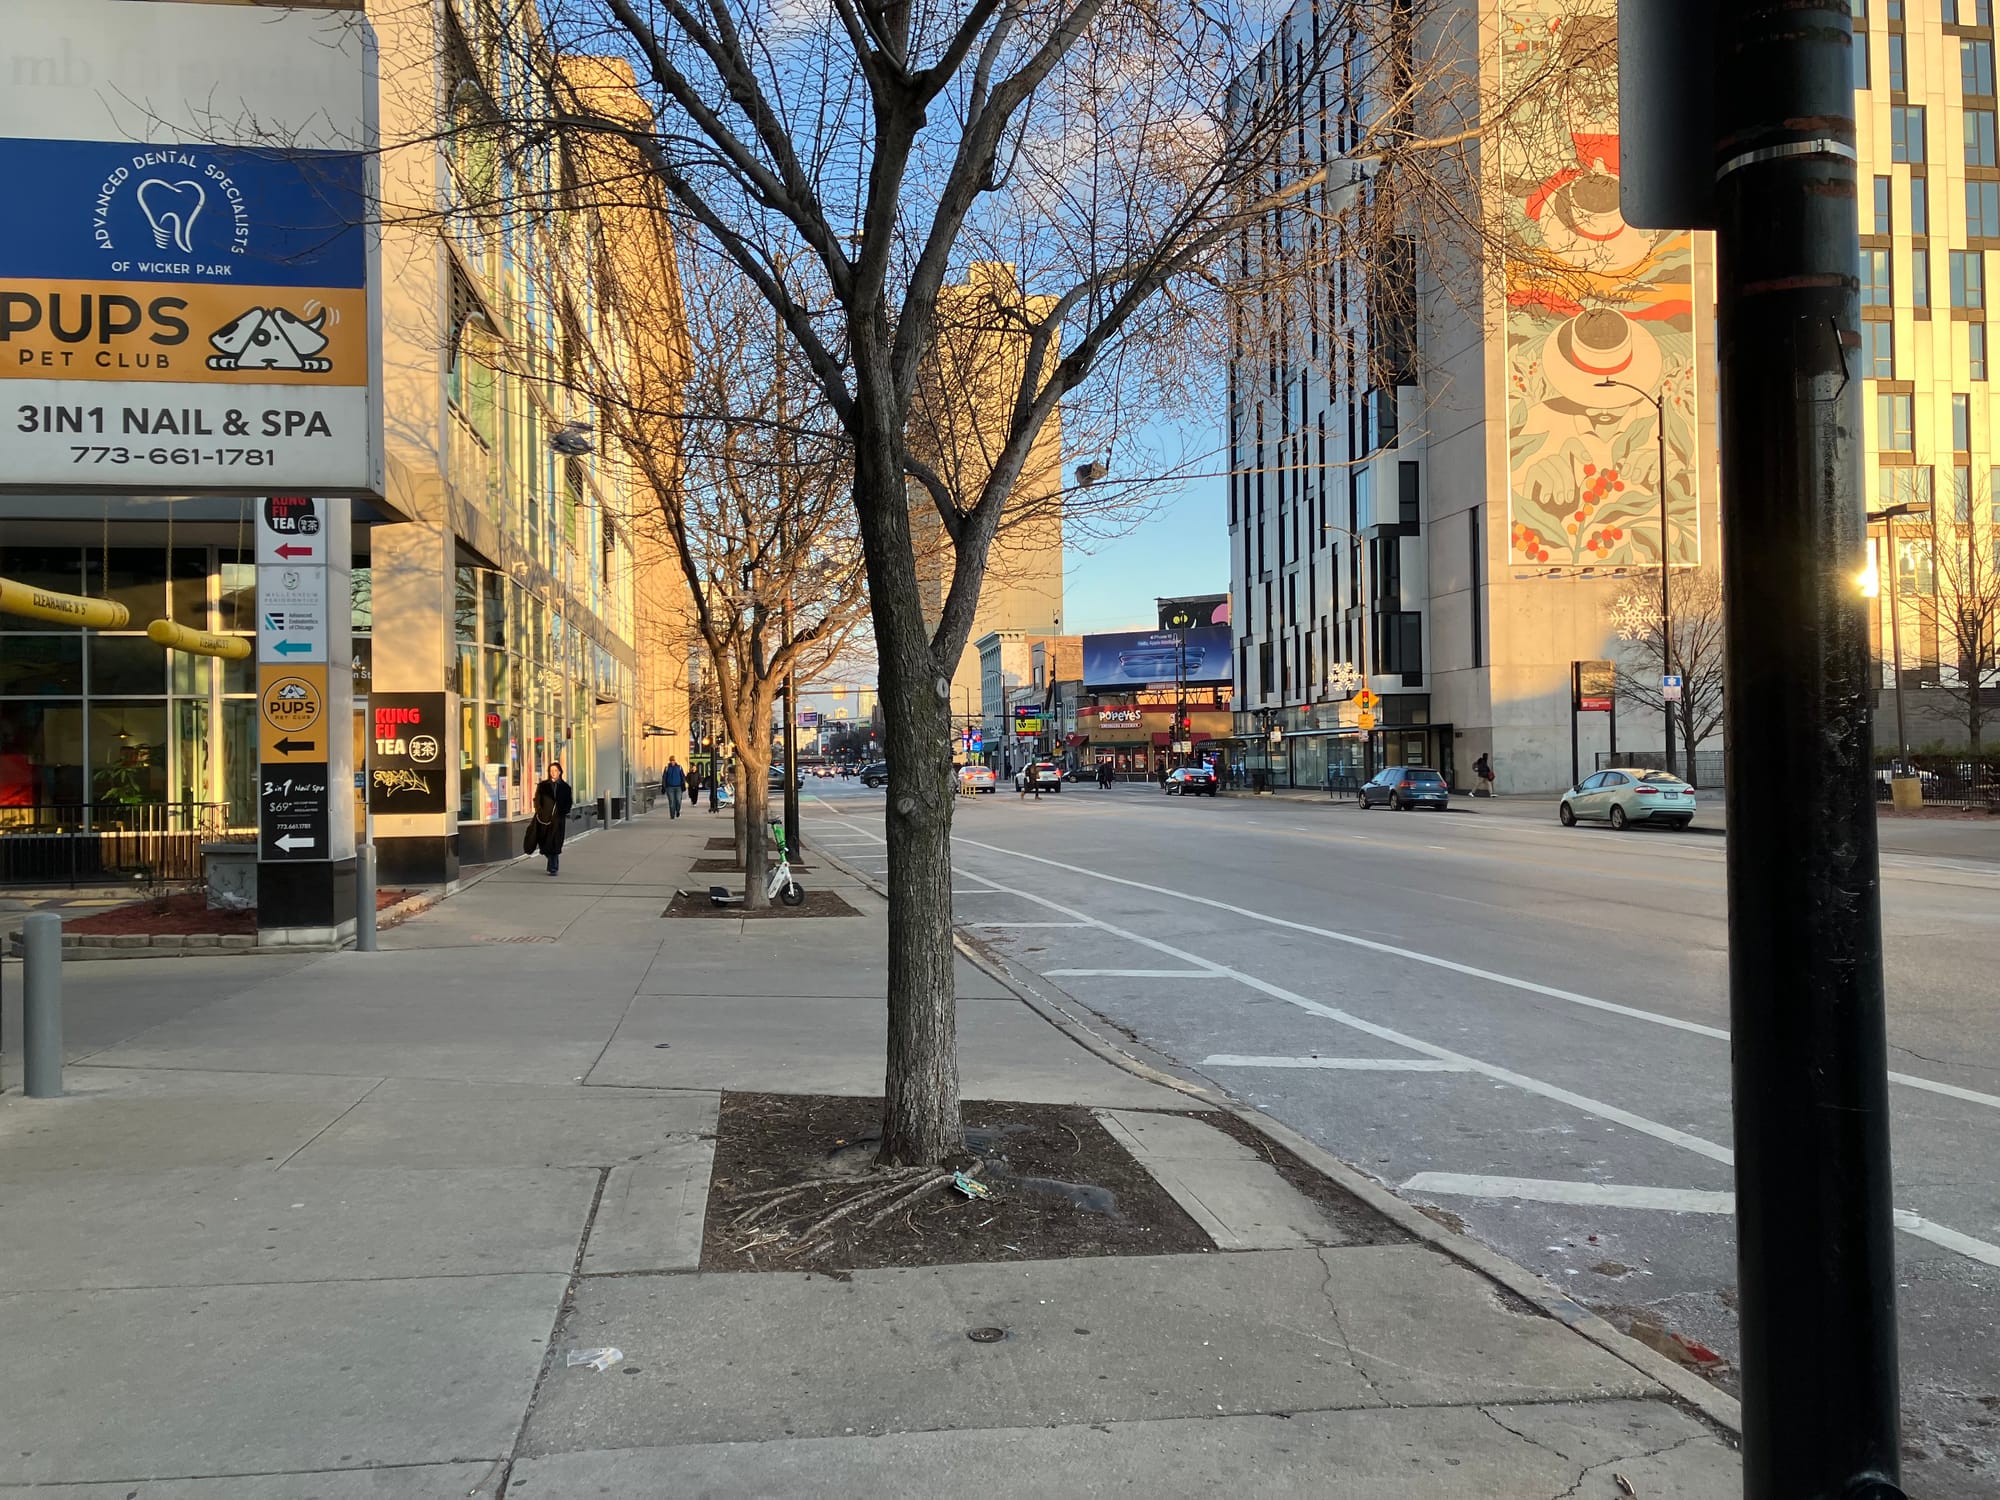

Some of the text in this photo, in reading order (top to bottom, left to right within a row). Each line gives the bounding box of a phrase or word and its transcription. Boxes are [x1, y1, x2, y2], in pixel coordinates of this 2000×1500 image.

[95, 150, 249, 255] ADVANCED DENTAL SPECIALISTS
[111, 261, 232, 276] OF WICKER PARK
[0, 291, 190, 346] PUPS
[19, 349, 170, 369] PET CLUB
[17, 404, 332, 437] 3IN1 NAIL & SPA
[70, 446, 275, 466] 773-661-1781
[272, 506, 288, 517] FU
[272, 517, 296, 529] TEA
[270, 701, 315, 714] PUPS
[375, 708, 420, 724] KUNG
[375, 724, 397, 739] FU
[375, 739, 406, 755] TEA
